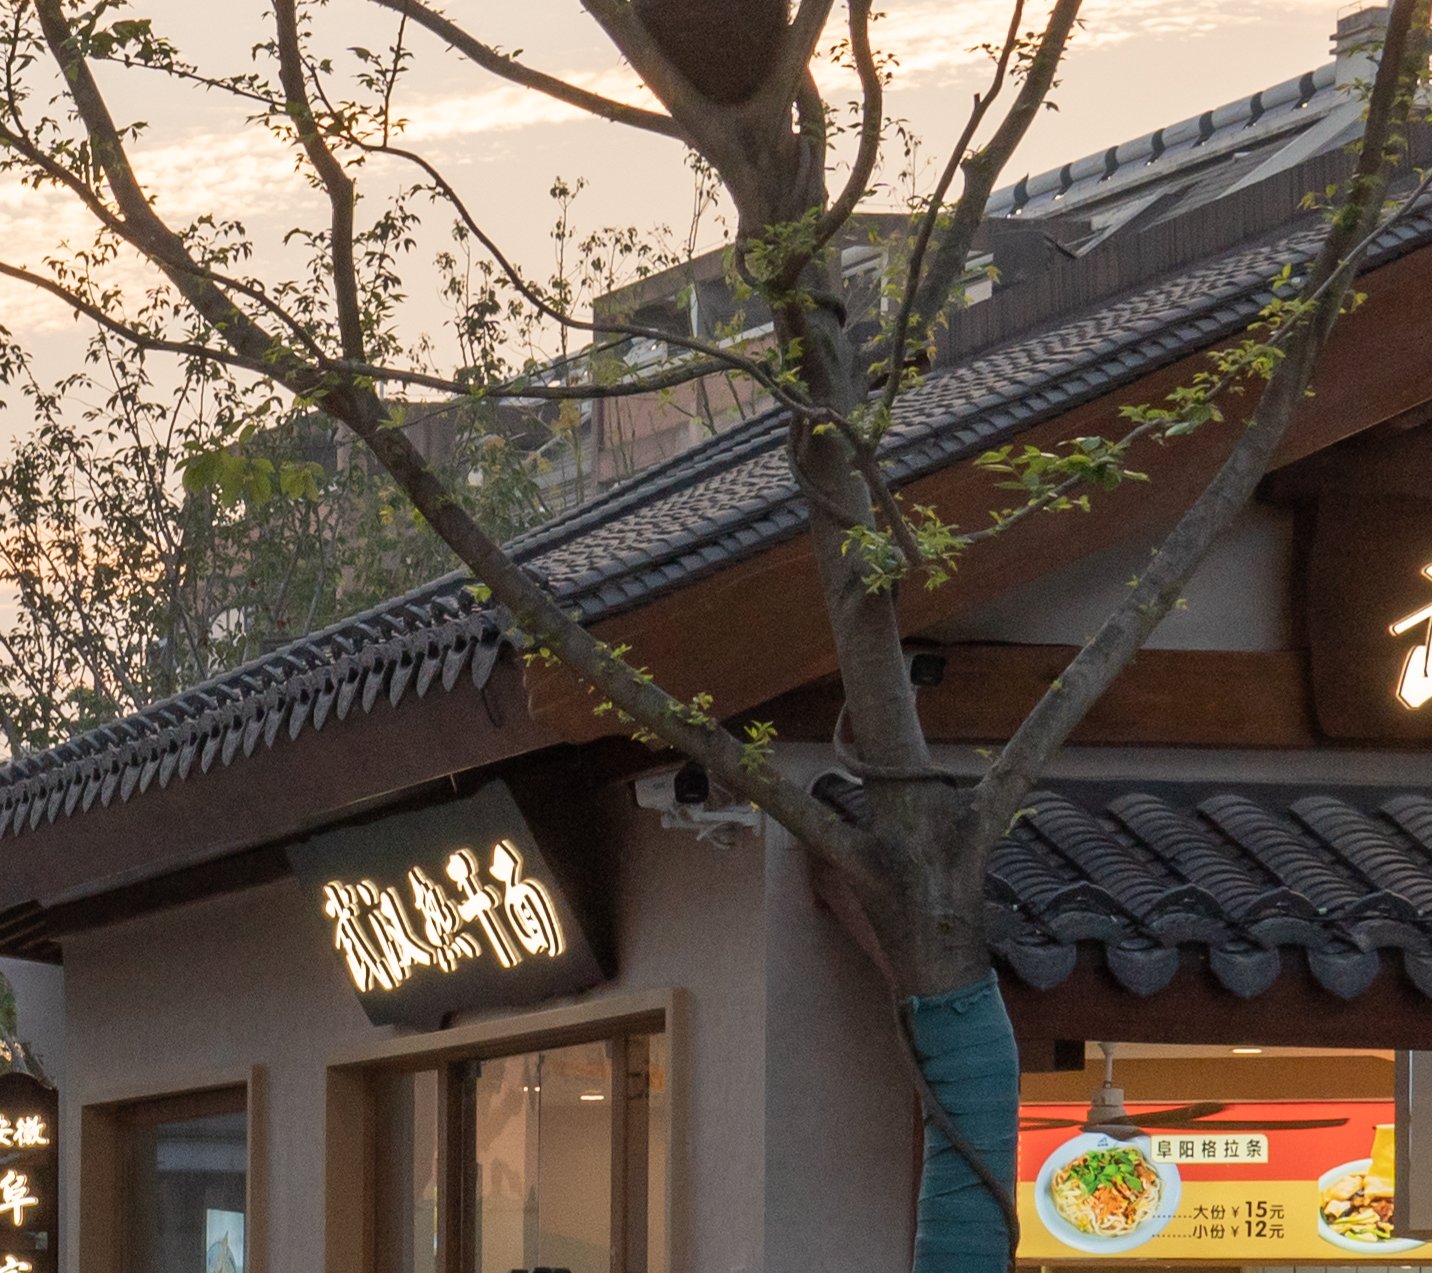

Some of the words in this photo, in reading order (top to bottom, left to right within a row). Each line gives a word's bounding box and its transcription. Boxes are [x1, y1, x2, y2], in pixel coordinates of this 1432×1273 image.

[323, 839, 566, 994] 武汉热干面
[1156, 1139, 1263, 1159] 阜阳格拉条
